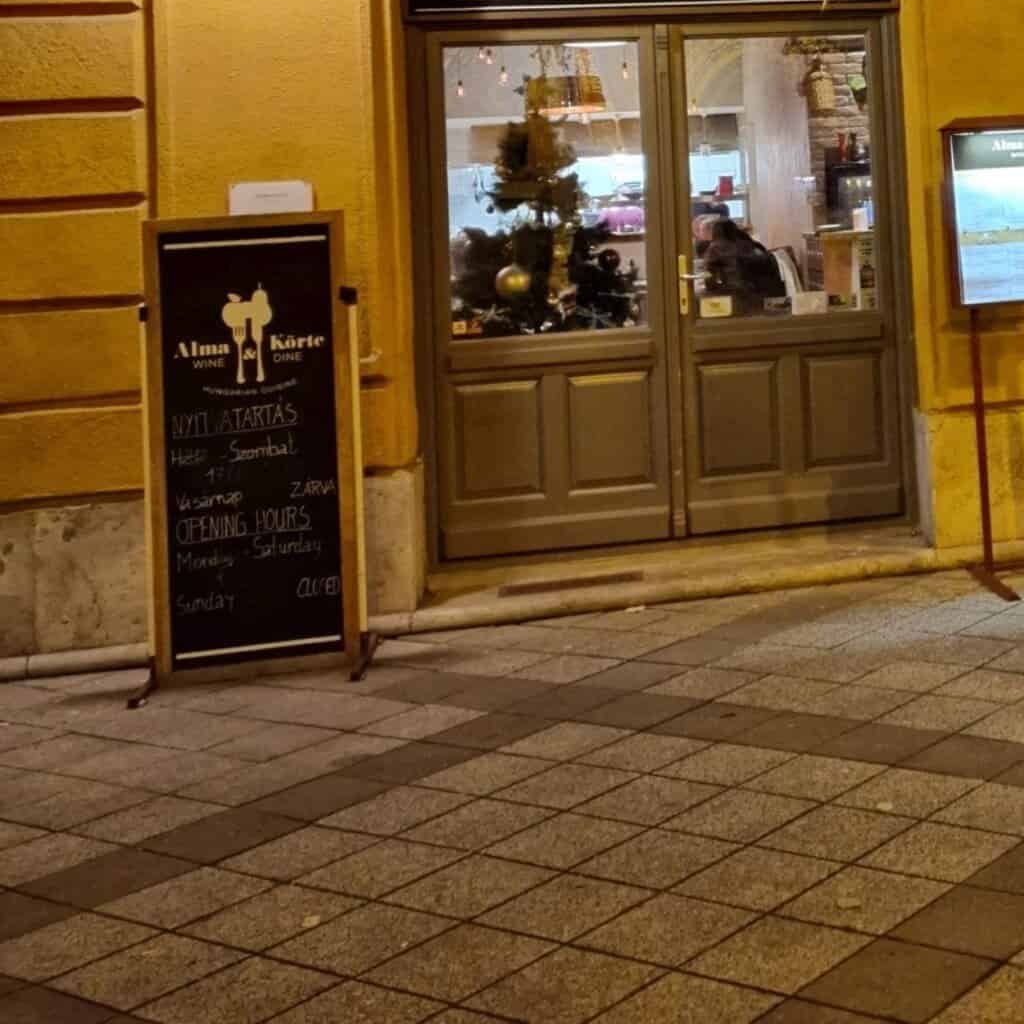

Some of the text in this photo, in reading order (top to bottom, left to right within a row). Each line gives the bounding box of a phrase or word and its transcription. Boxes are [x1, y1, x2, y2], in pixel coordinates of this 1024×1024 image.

[172, 333, 327, 361] Alma & Körte
[191, 351, 304, 369] WINE DINE
